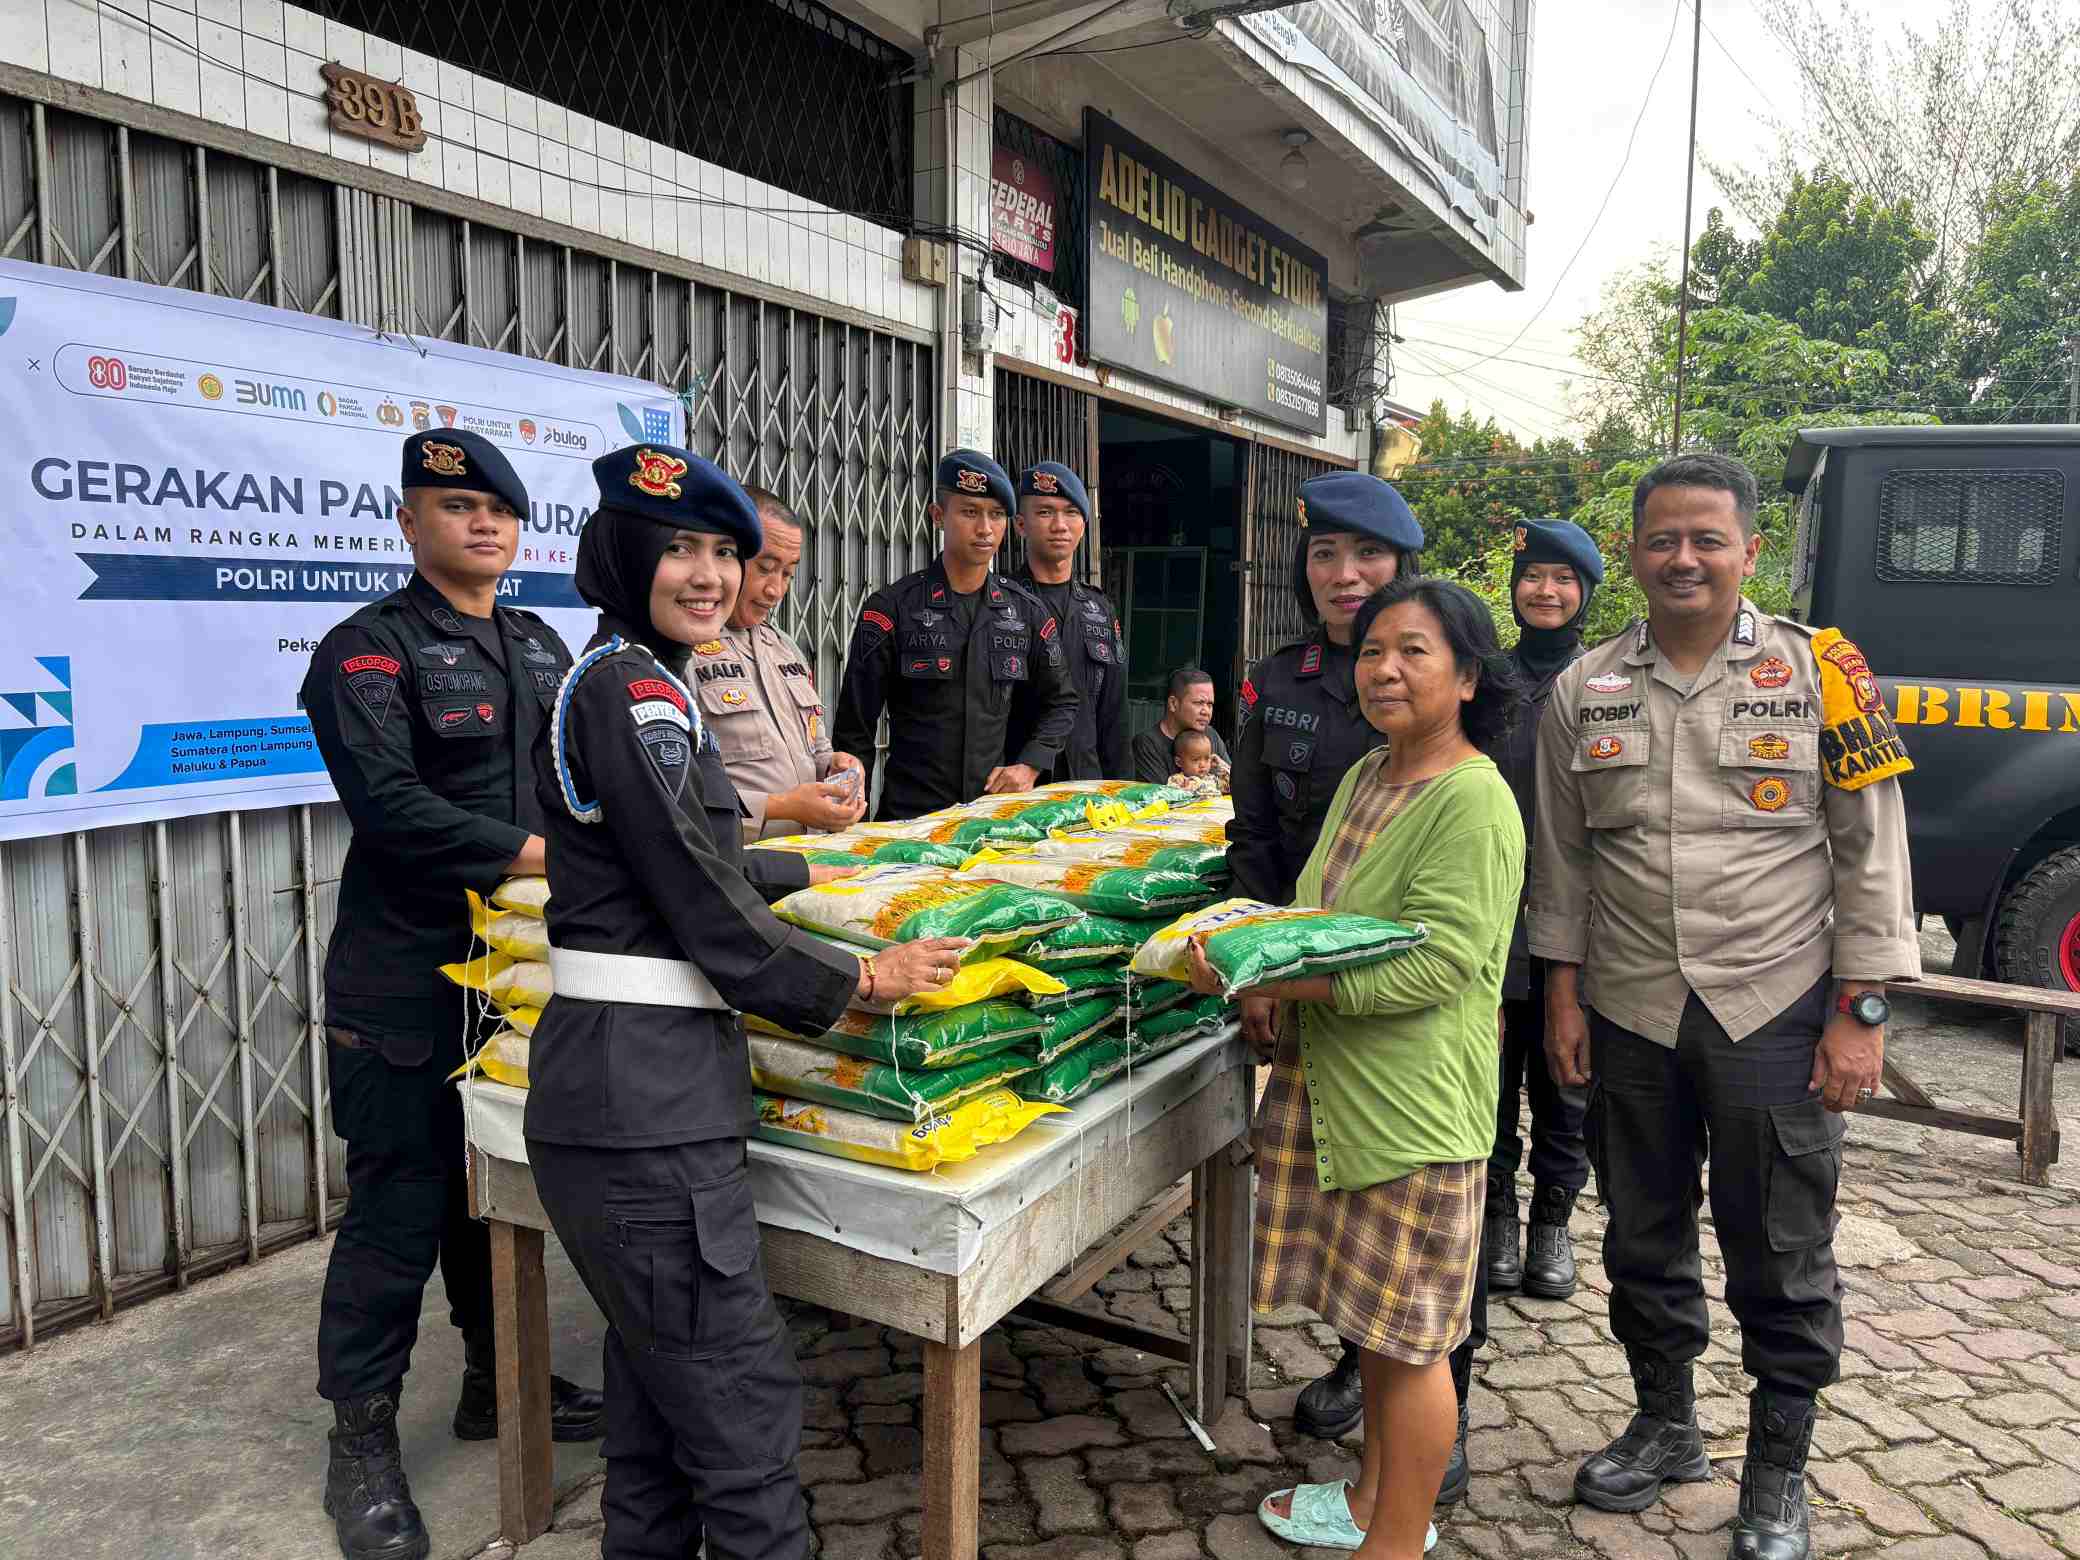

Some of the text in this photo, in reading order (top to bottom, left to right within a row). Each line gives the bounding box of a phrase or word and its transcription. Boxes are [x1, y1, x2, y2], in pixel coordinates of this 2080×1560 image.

[338, 78, 417, 137] 39B
[992, 178, 1052, 230] FEDERAL
[993, 208, 1051, 241] ARTS
[1100, 144, 1321, 317] ADELIO GADGET STORE
[1099, 220, 1129, 263] Jual
[1133, 232, 1158, 277] Beli
[1161, 251, 1230, 307] Handphone
[1232, 287, 1269, 329] Second
[88, 355, 126, 390] 80
[553, 428, 587, 450] bulog
[31, 457, 304, 515] GERAKAN
[71, 523, 172, 543] DALAM
[190, 528, 298, 548] RANGKA
[314, 534, 414, 553] MEMERI
[216, 567, 293, 592] POLRI
[303, 570, 389, 592] UNTUK
[908, 631, 946, 648] ARYA
[993, 635, 1029, 650] POLRI
[349, 657, 396, 671] PELOPOR
[1265, 706, 1320, 732] FEBRI
[1579, 703, 1641, 723] ROBBY
[1733, 700, 1809, 718] POLRI
[171, 739, 313, 757] Sumatera (non Lampung
[172, 730, 207, 742] Jawa,
[172, 757, 267, 774] Maluku & Papua
